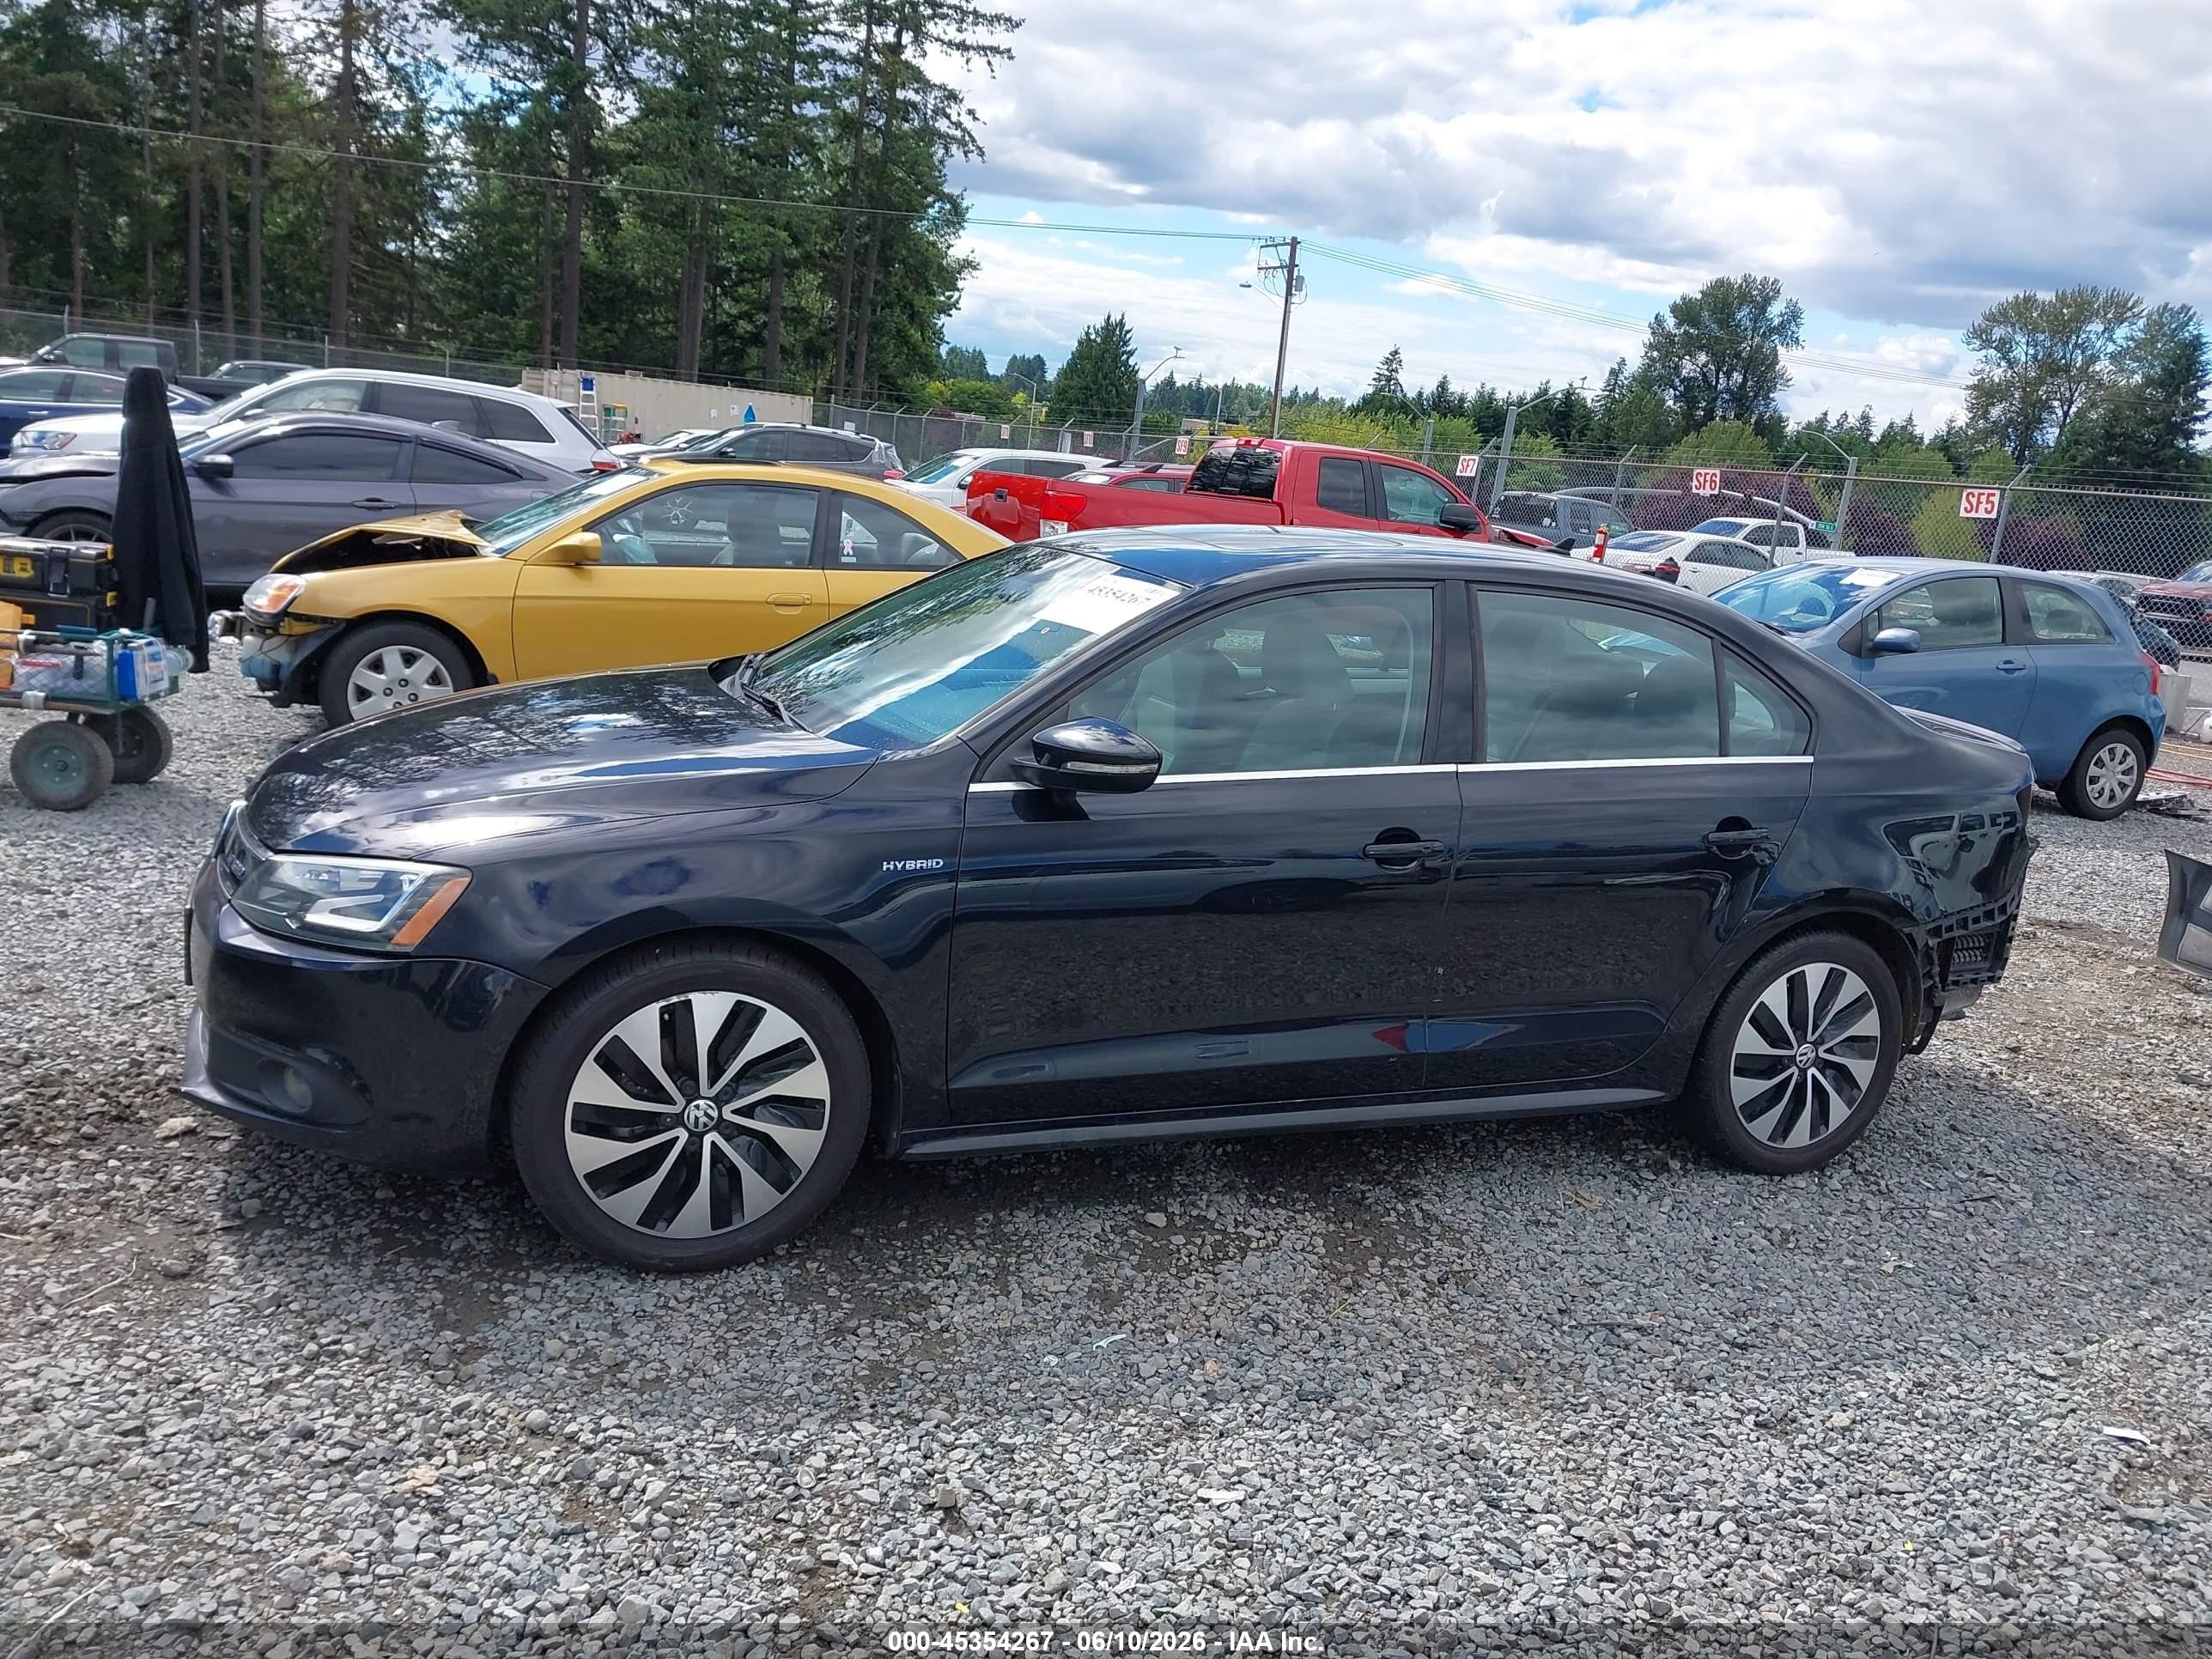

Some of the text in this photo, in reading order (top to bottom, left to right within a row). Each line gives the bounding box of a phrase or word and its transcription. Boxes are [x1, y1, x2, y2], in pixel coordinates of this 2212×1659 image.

[1177, 439, 1188, 453] SF9
[1459, 458, 1476, 474] SF7
[1694, 471, 1717, 491] SF6
[1963, 491, 1996, 514] SF5
[882, 859, 944, 871] HYBRID
